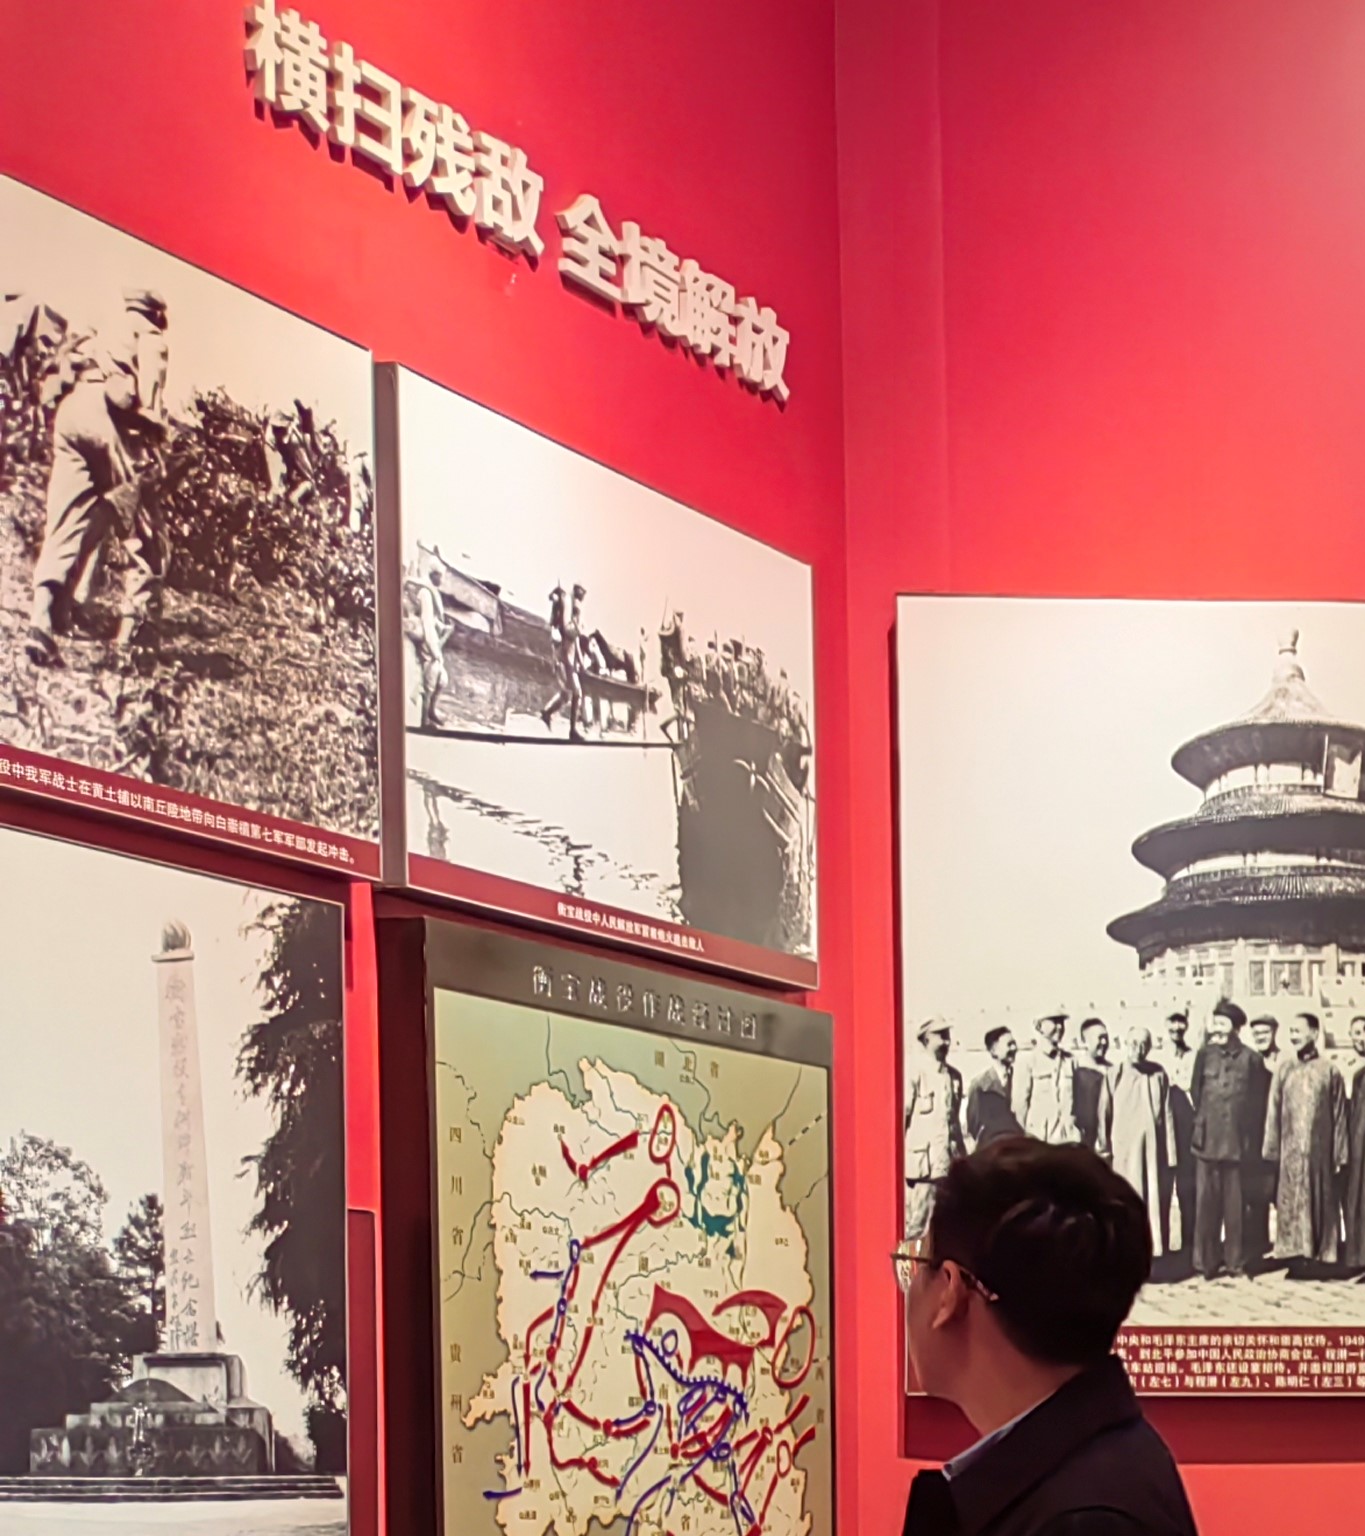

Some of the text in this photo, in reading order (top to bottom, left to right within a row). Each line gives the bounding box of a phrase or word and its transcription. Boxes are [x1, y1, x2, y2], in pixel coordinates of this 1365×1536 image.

[243, 0, 790, 402] 横扫残敌 全境解放
